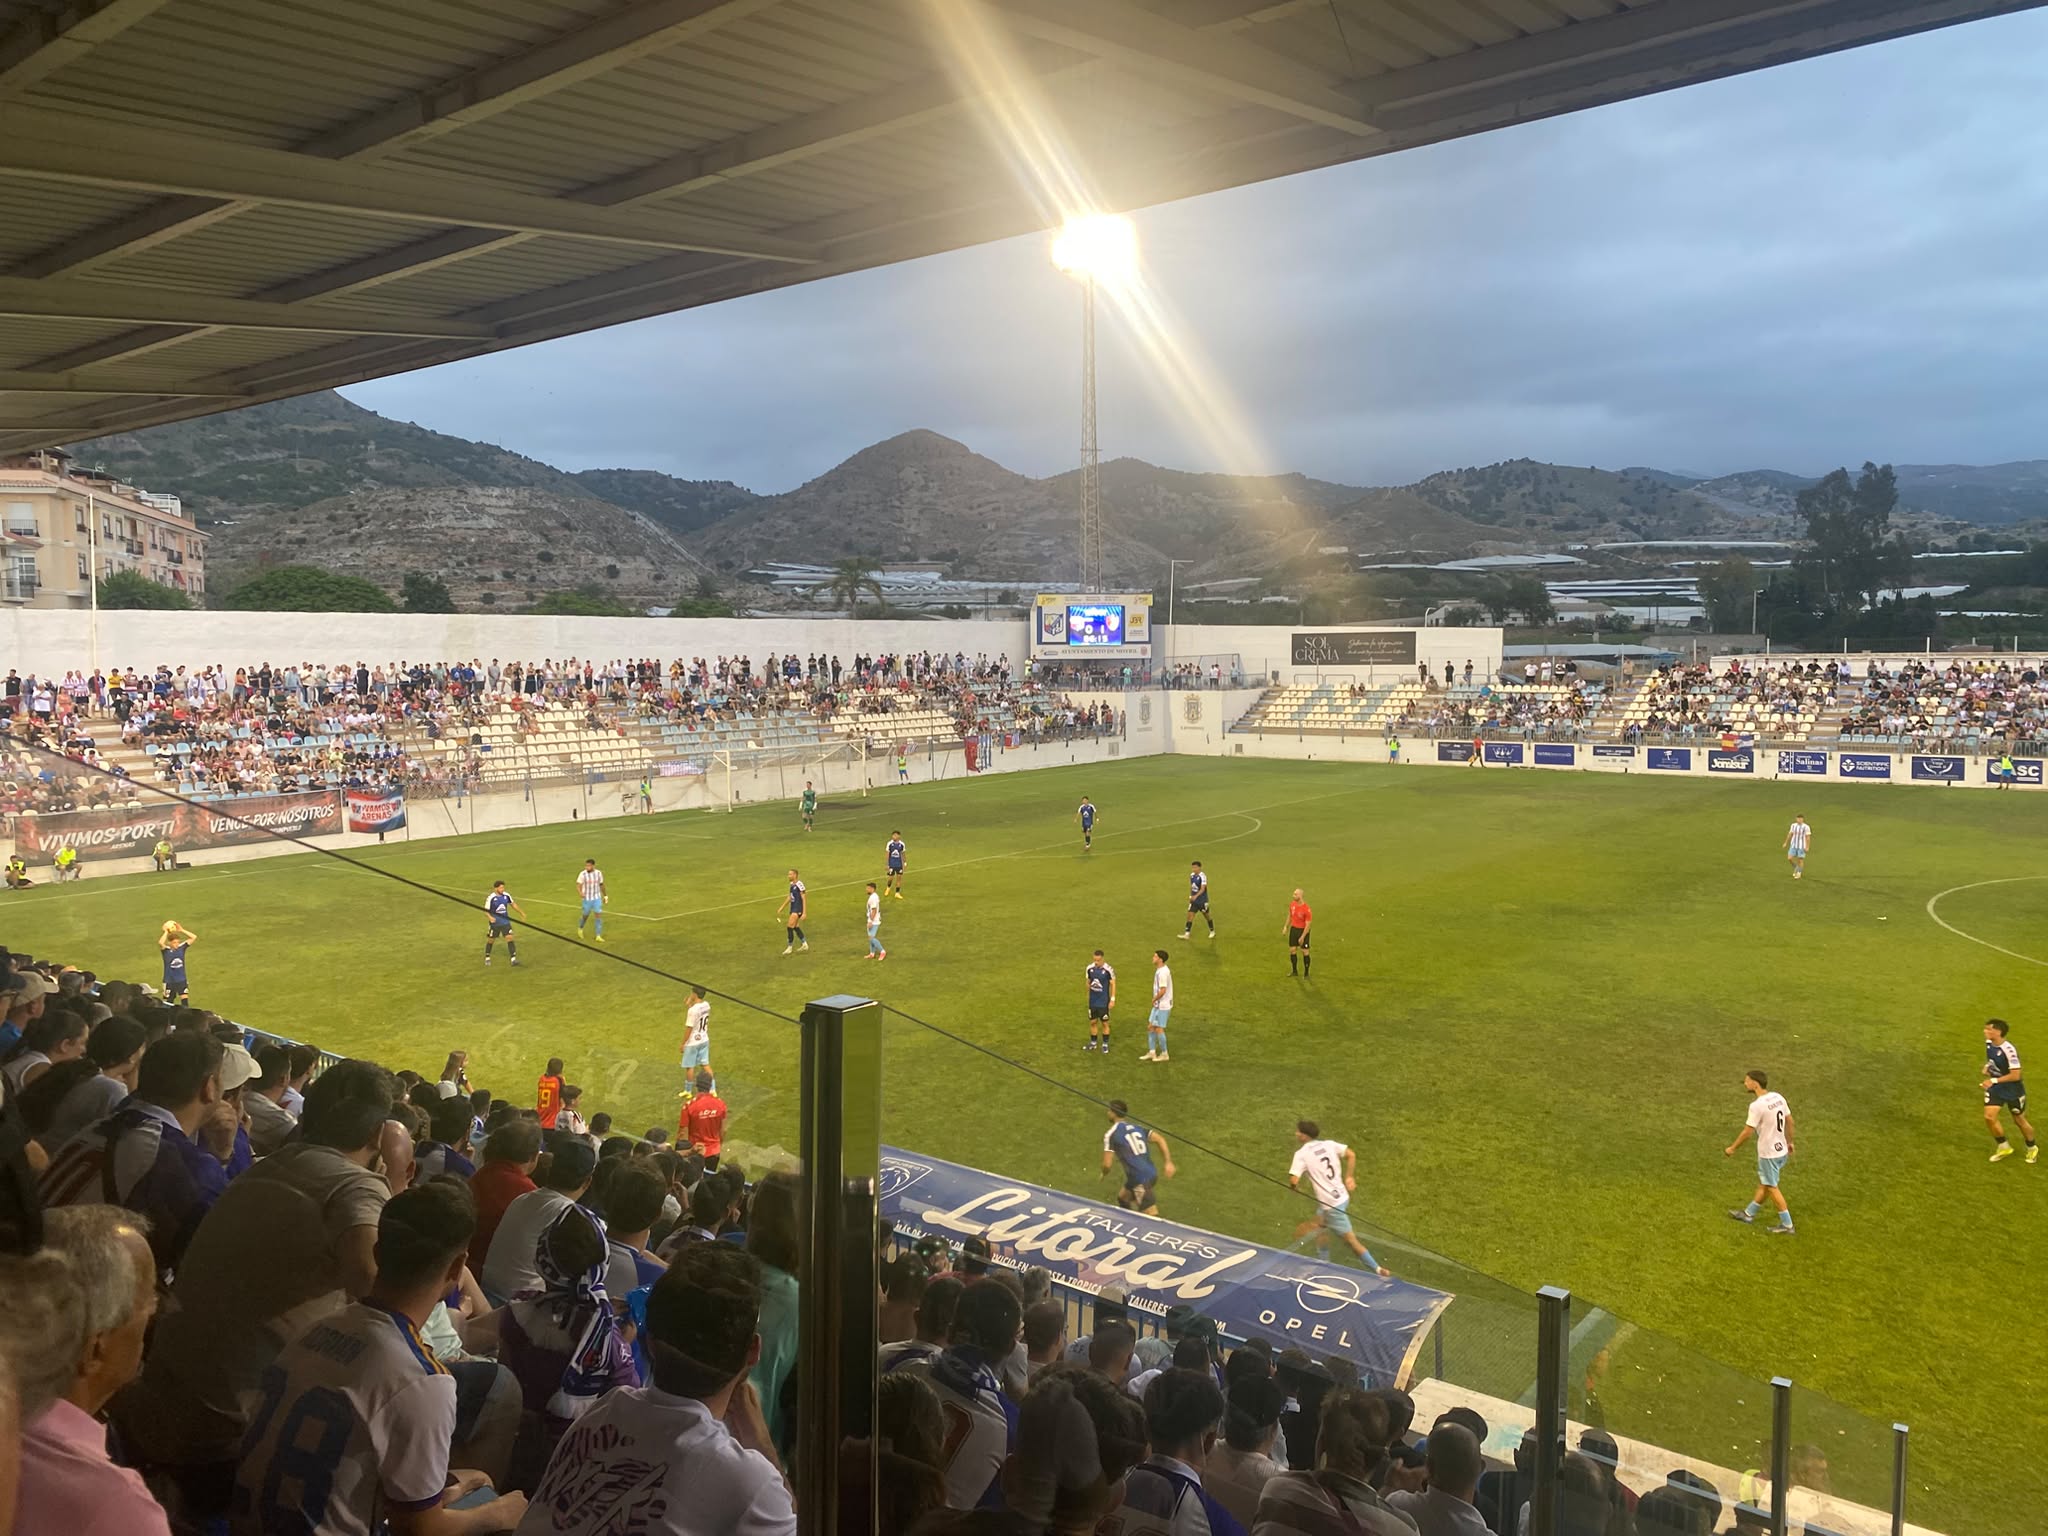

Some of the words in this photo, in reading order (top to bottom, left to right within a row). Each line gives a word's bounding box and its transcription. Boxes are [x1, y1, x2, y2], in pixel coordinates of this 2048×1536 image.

[209, 813, 250, 834] VENCE
[252, 811, 277, 827] POR
[277, 803, 335, 825] NOSOTROS
[361, 811, 392, 821] ARENAS
[38, 827, 117, 852] VIVIMOS
[120, 823, 156, 841] POR
[158, 820, 176, 835] TI
[1776, 1110, 1784, 1133] 6
[1124, 1131, 1147, 1156] 16
[1320, 1156, 1335, 1180] 3
[921, 1188, 1258, 1300] Litoral
[1085, 1213, 1221, 1260] TALLERES
[1258, 1309, 1353, 1348] OPEL
